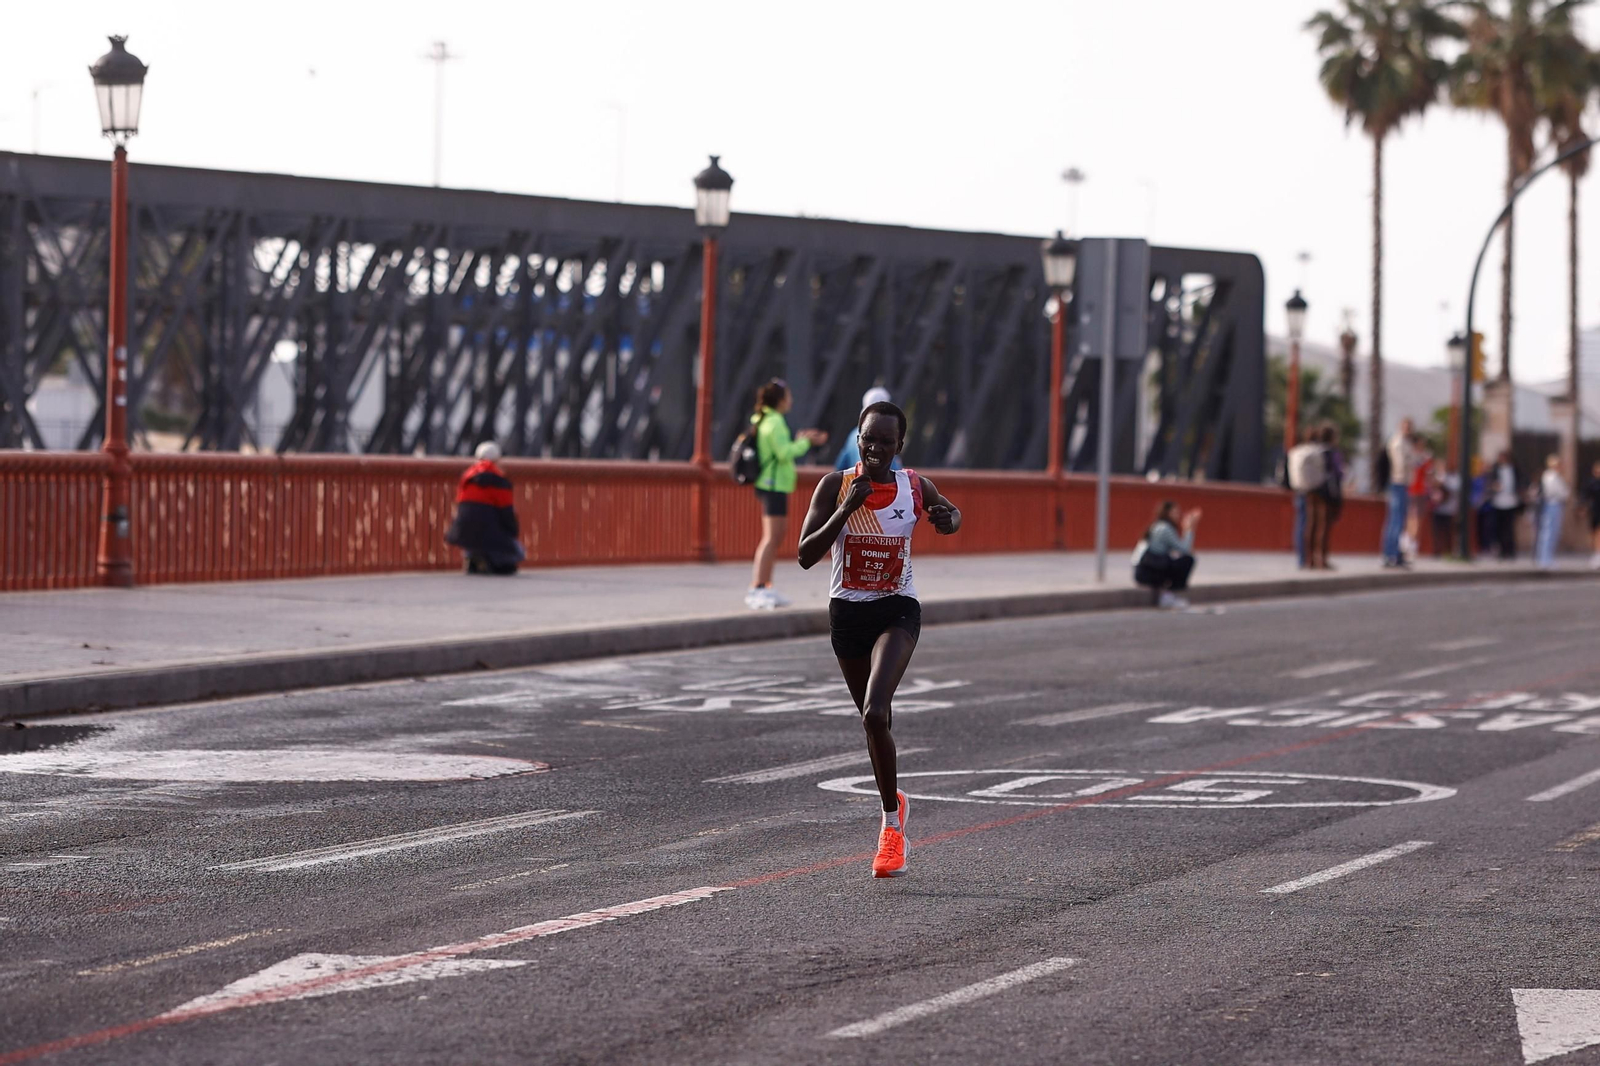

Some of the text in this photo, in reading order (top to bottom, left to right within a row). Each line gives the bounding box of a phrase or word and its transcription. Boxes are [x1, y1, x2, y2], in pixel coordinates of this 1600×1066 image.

[861, 549, 890, 559] DORINE
[865, 561, 884, 570] F-32
[967, 776, 1308, 803] 50
